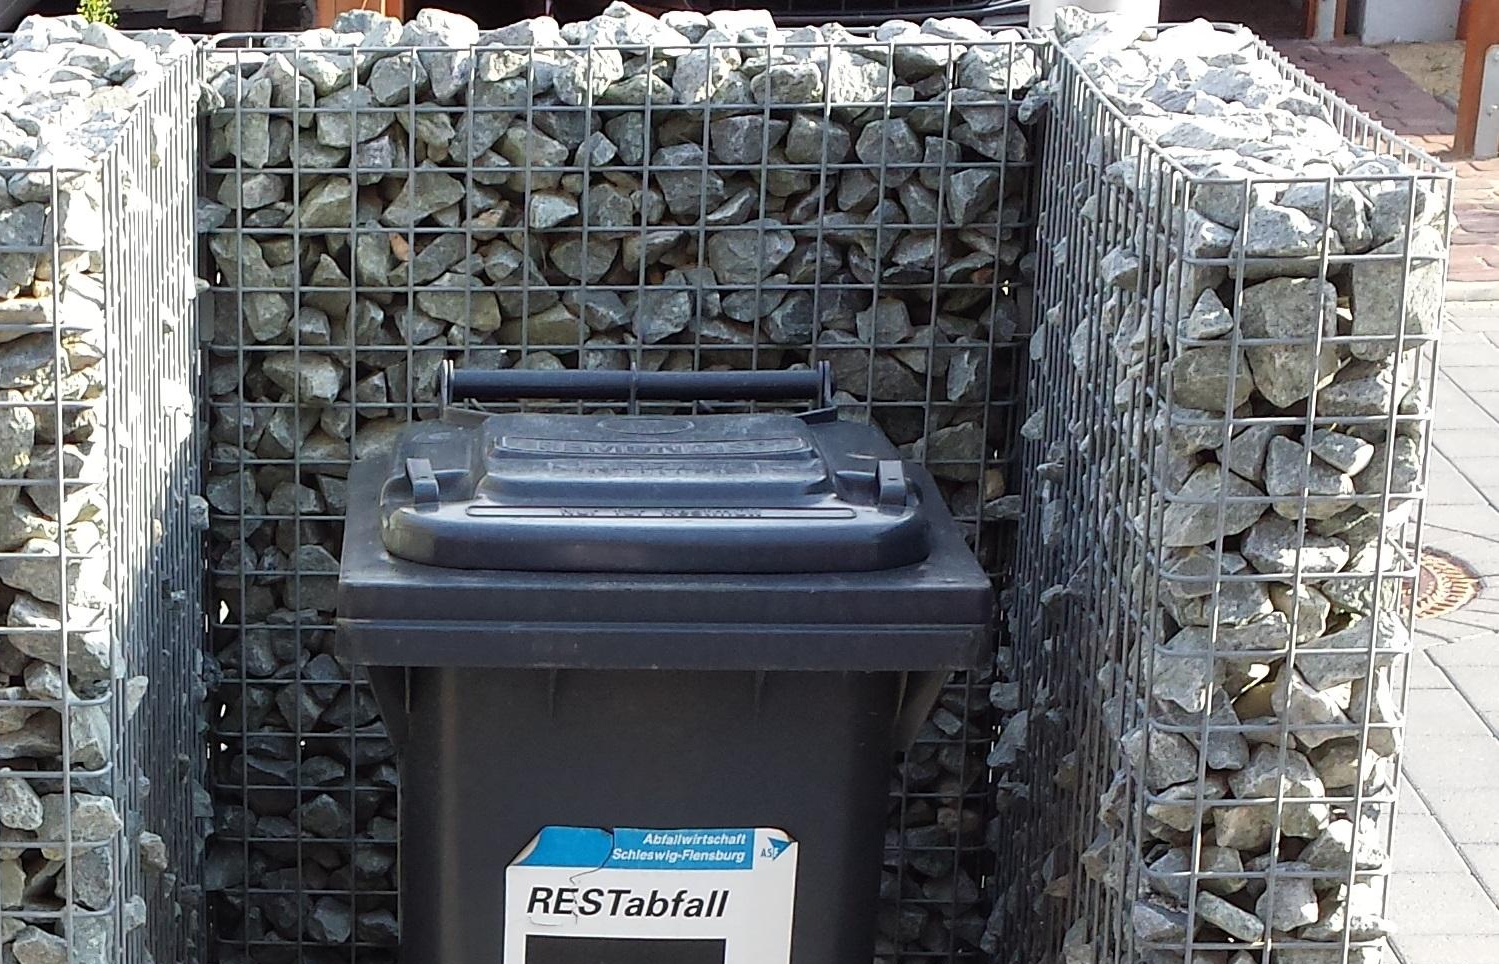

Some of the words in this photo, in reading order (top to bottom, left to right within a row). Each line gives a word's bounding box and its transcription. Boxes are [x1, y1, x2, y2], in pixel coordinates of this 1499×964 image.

[642, 832, 747, 846] Abfallwirtschaft
[611, 847, 746, 864] Schleswig-Flensburg
[526, 886, 730, 918] RESTabfall
